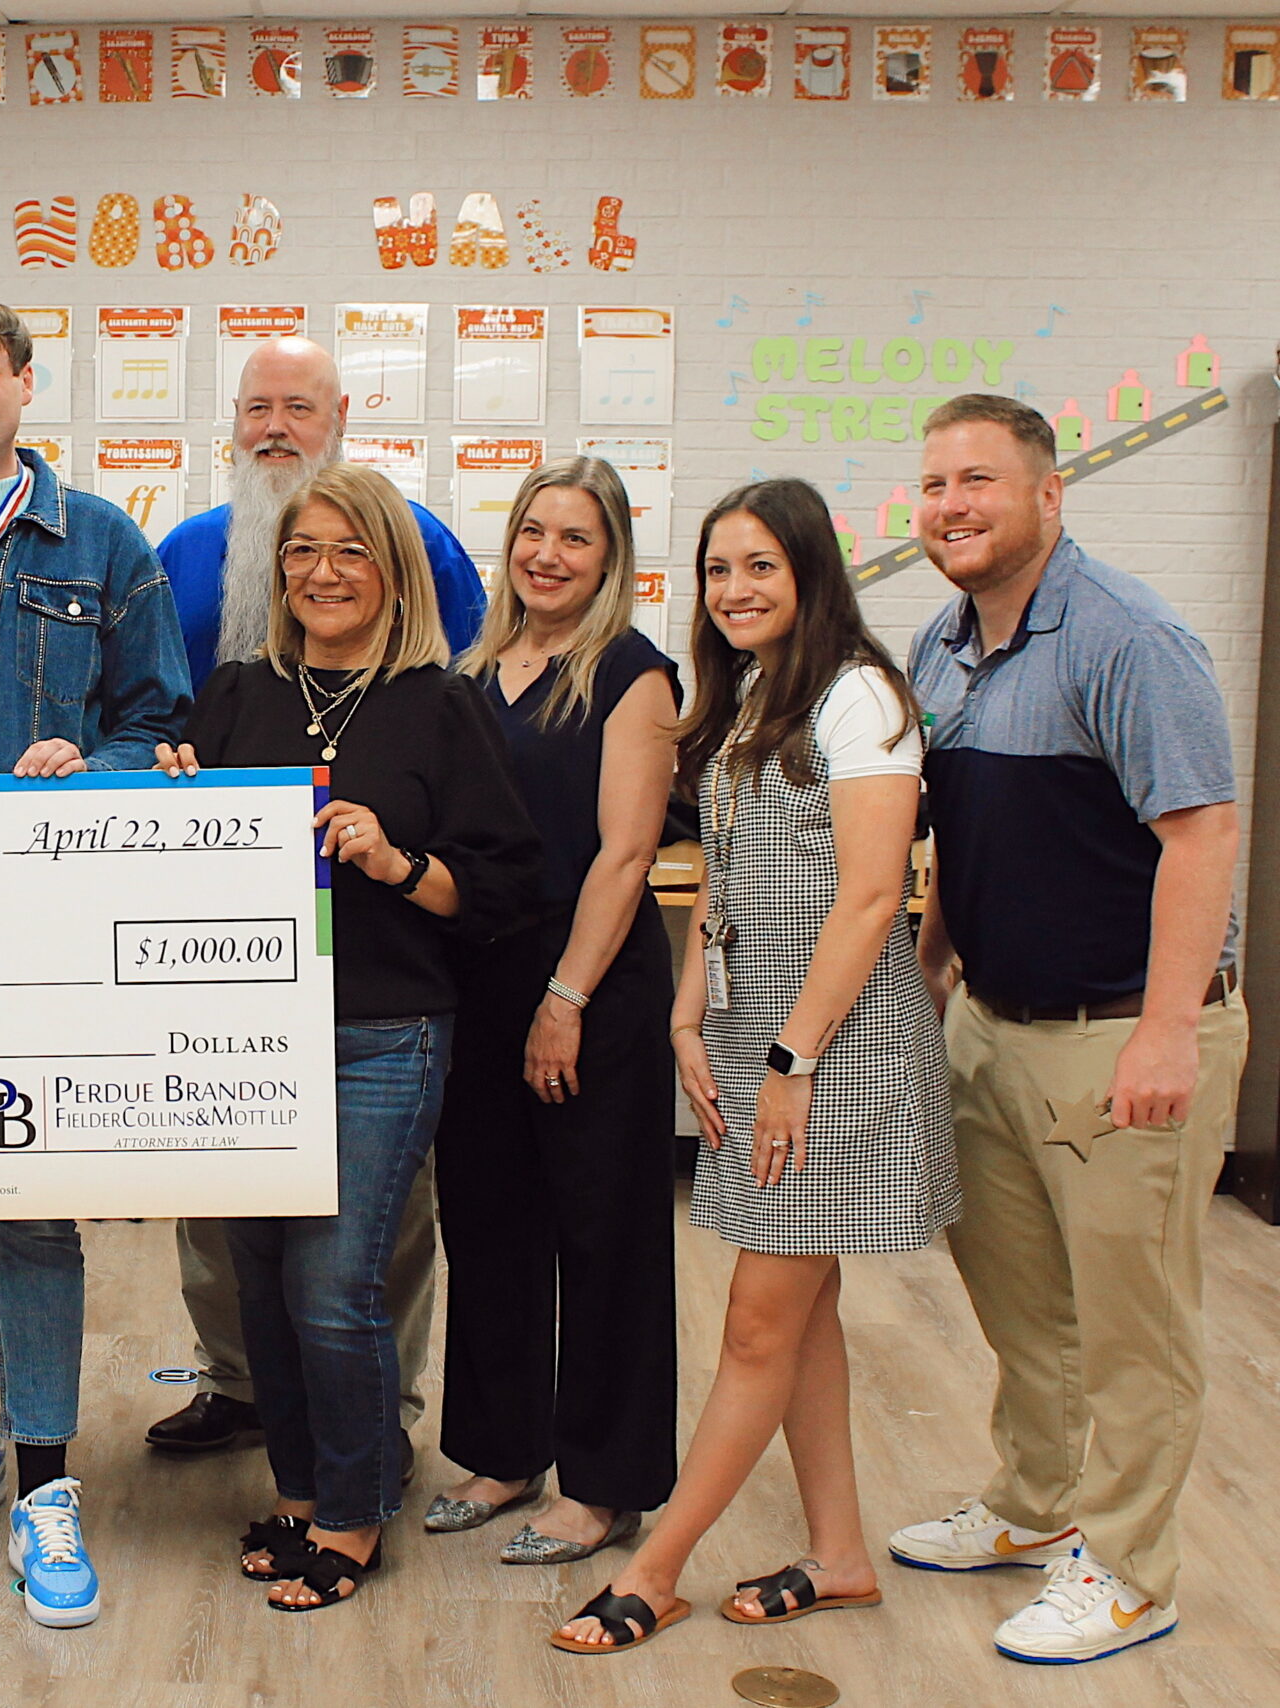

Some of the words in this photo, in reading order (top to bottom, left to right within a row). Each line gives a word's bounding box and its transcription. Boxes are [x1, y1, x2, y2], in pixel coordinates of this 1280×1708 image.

[14, 192, 284, 270] WORD
[372, 192, 638, 273] WALL
[274, 317, 295, 327] NOTE
[751, 336, 1014, 386] MELODY
[106, 447, 172, 459] FORTISSIMO
[466, 447, 496, 459] HALF
[501, 447, 531, 459] REST
[19, 815, 118, 861] April
[120, 819, 169, 854] 22,
[182, 816, 263, 848] 2025
[134, 936, 283, 970] $1,000.00
[167, 1031, 290, 1055] DOLLARS
[55, 1076, 155, 1103] PERDUE
[165, 1074, 297, 1102] BRANDON
[270, 1109, 297, 1125] LLP
[113, 1137, 189, 1148] ATTORNEYS
[192, 1136, 209, 1147] AT
[211, 1136, 239, 1147] LAW
